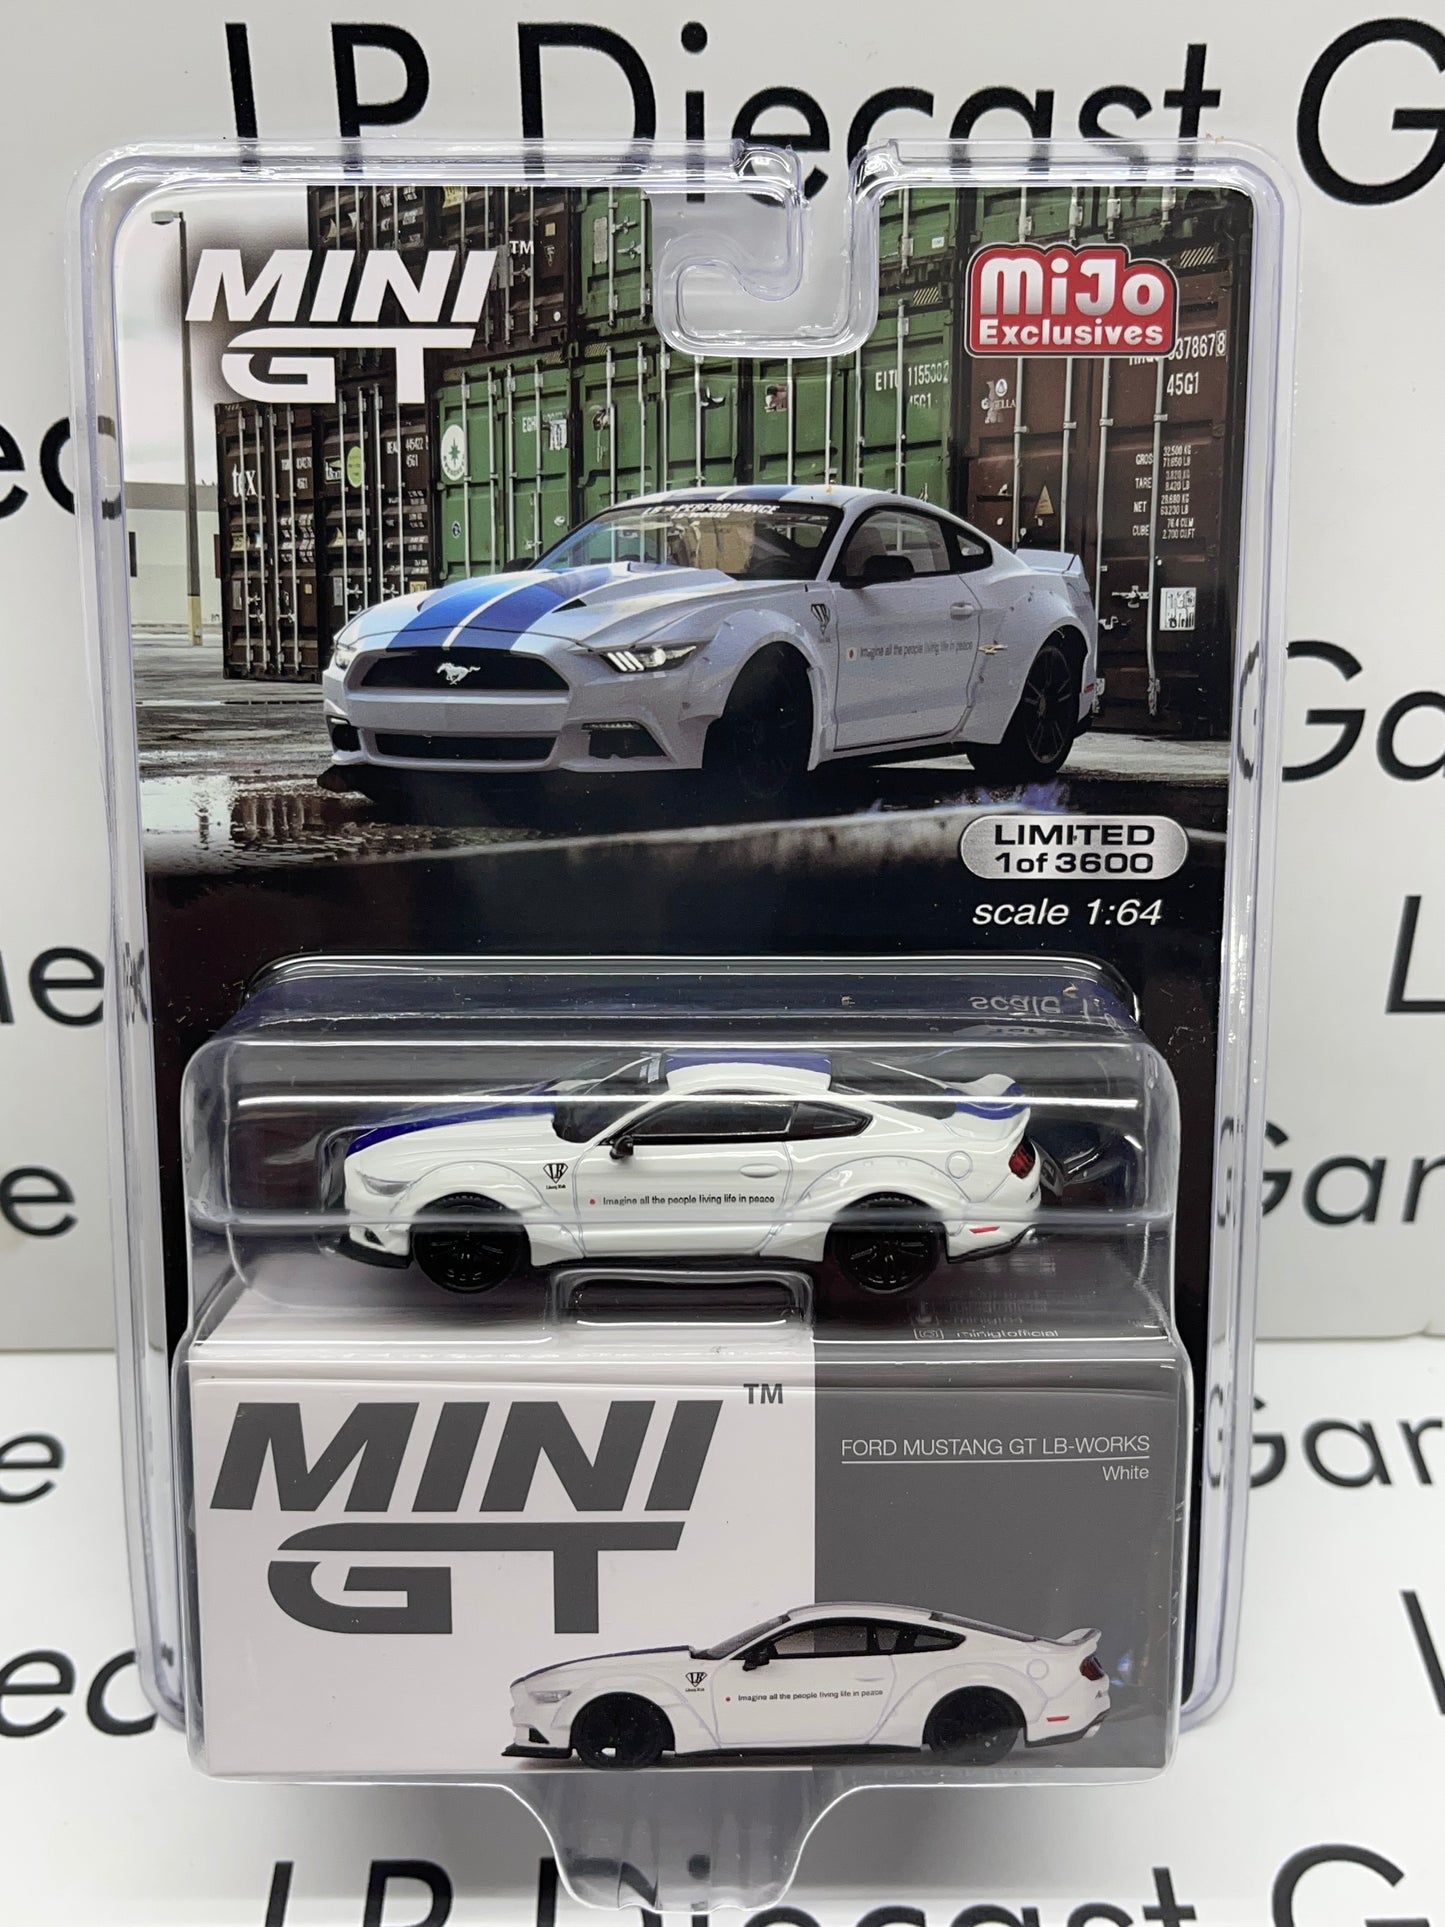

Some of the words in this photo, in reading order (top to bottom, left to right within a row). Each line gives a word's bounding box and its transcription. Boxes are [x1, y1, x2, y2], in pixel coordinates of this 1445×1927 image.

[518, 22, 1221, 205] Diecast
[185, 249, 497, 322] MINI
[979, 318, 1164, 346] Exclusives
[221, 328, 476, 404] GT
[1166, 371, 1199, 396] 45G1
[1135, 478, 1152, 489] TARE
[1133, 501, 1147, 513] NET
[1132, 525, 1150, 536] CUBE
[995, 825, 1155, 846] LIMITED
[972, 898, 1069, 925] scale
[1087, 899, 1163, 925] 1:64
[603, 1196, 638, 1206] Imagine
[639, 1195, 650, 1204] all
[652, 1195, 665, 1204] the
[668, 1195, 697, 1206] people
[699, 1194, 722, 1205] living
[723, 1194, 736, 1204] life
[738, 1194, 747, 1203] in
[748, 1195, 775, 1204] peace
[210, 1400, 723, 1512] MINI
[841, 1439, 898, 1457] FORD
[903, 1438, 1003, 1457] MUSTANG
[1008, 1437, 1037, 1455] GT
[1042, 1434, 1151, 1454] LB-WORKS
[1102, 1465, 1150, 1481] White
[268, 1521, 686, 1634] GT
[738, 1694, 768, 1702] Imagine
[792, 1692, 818, 1702] people
[819, 1690, 839, 1700] living
[861, 1690, 883, 1698] peace
